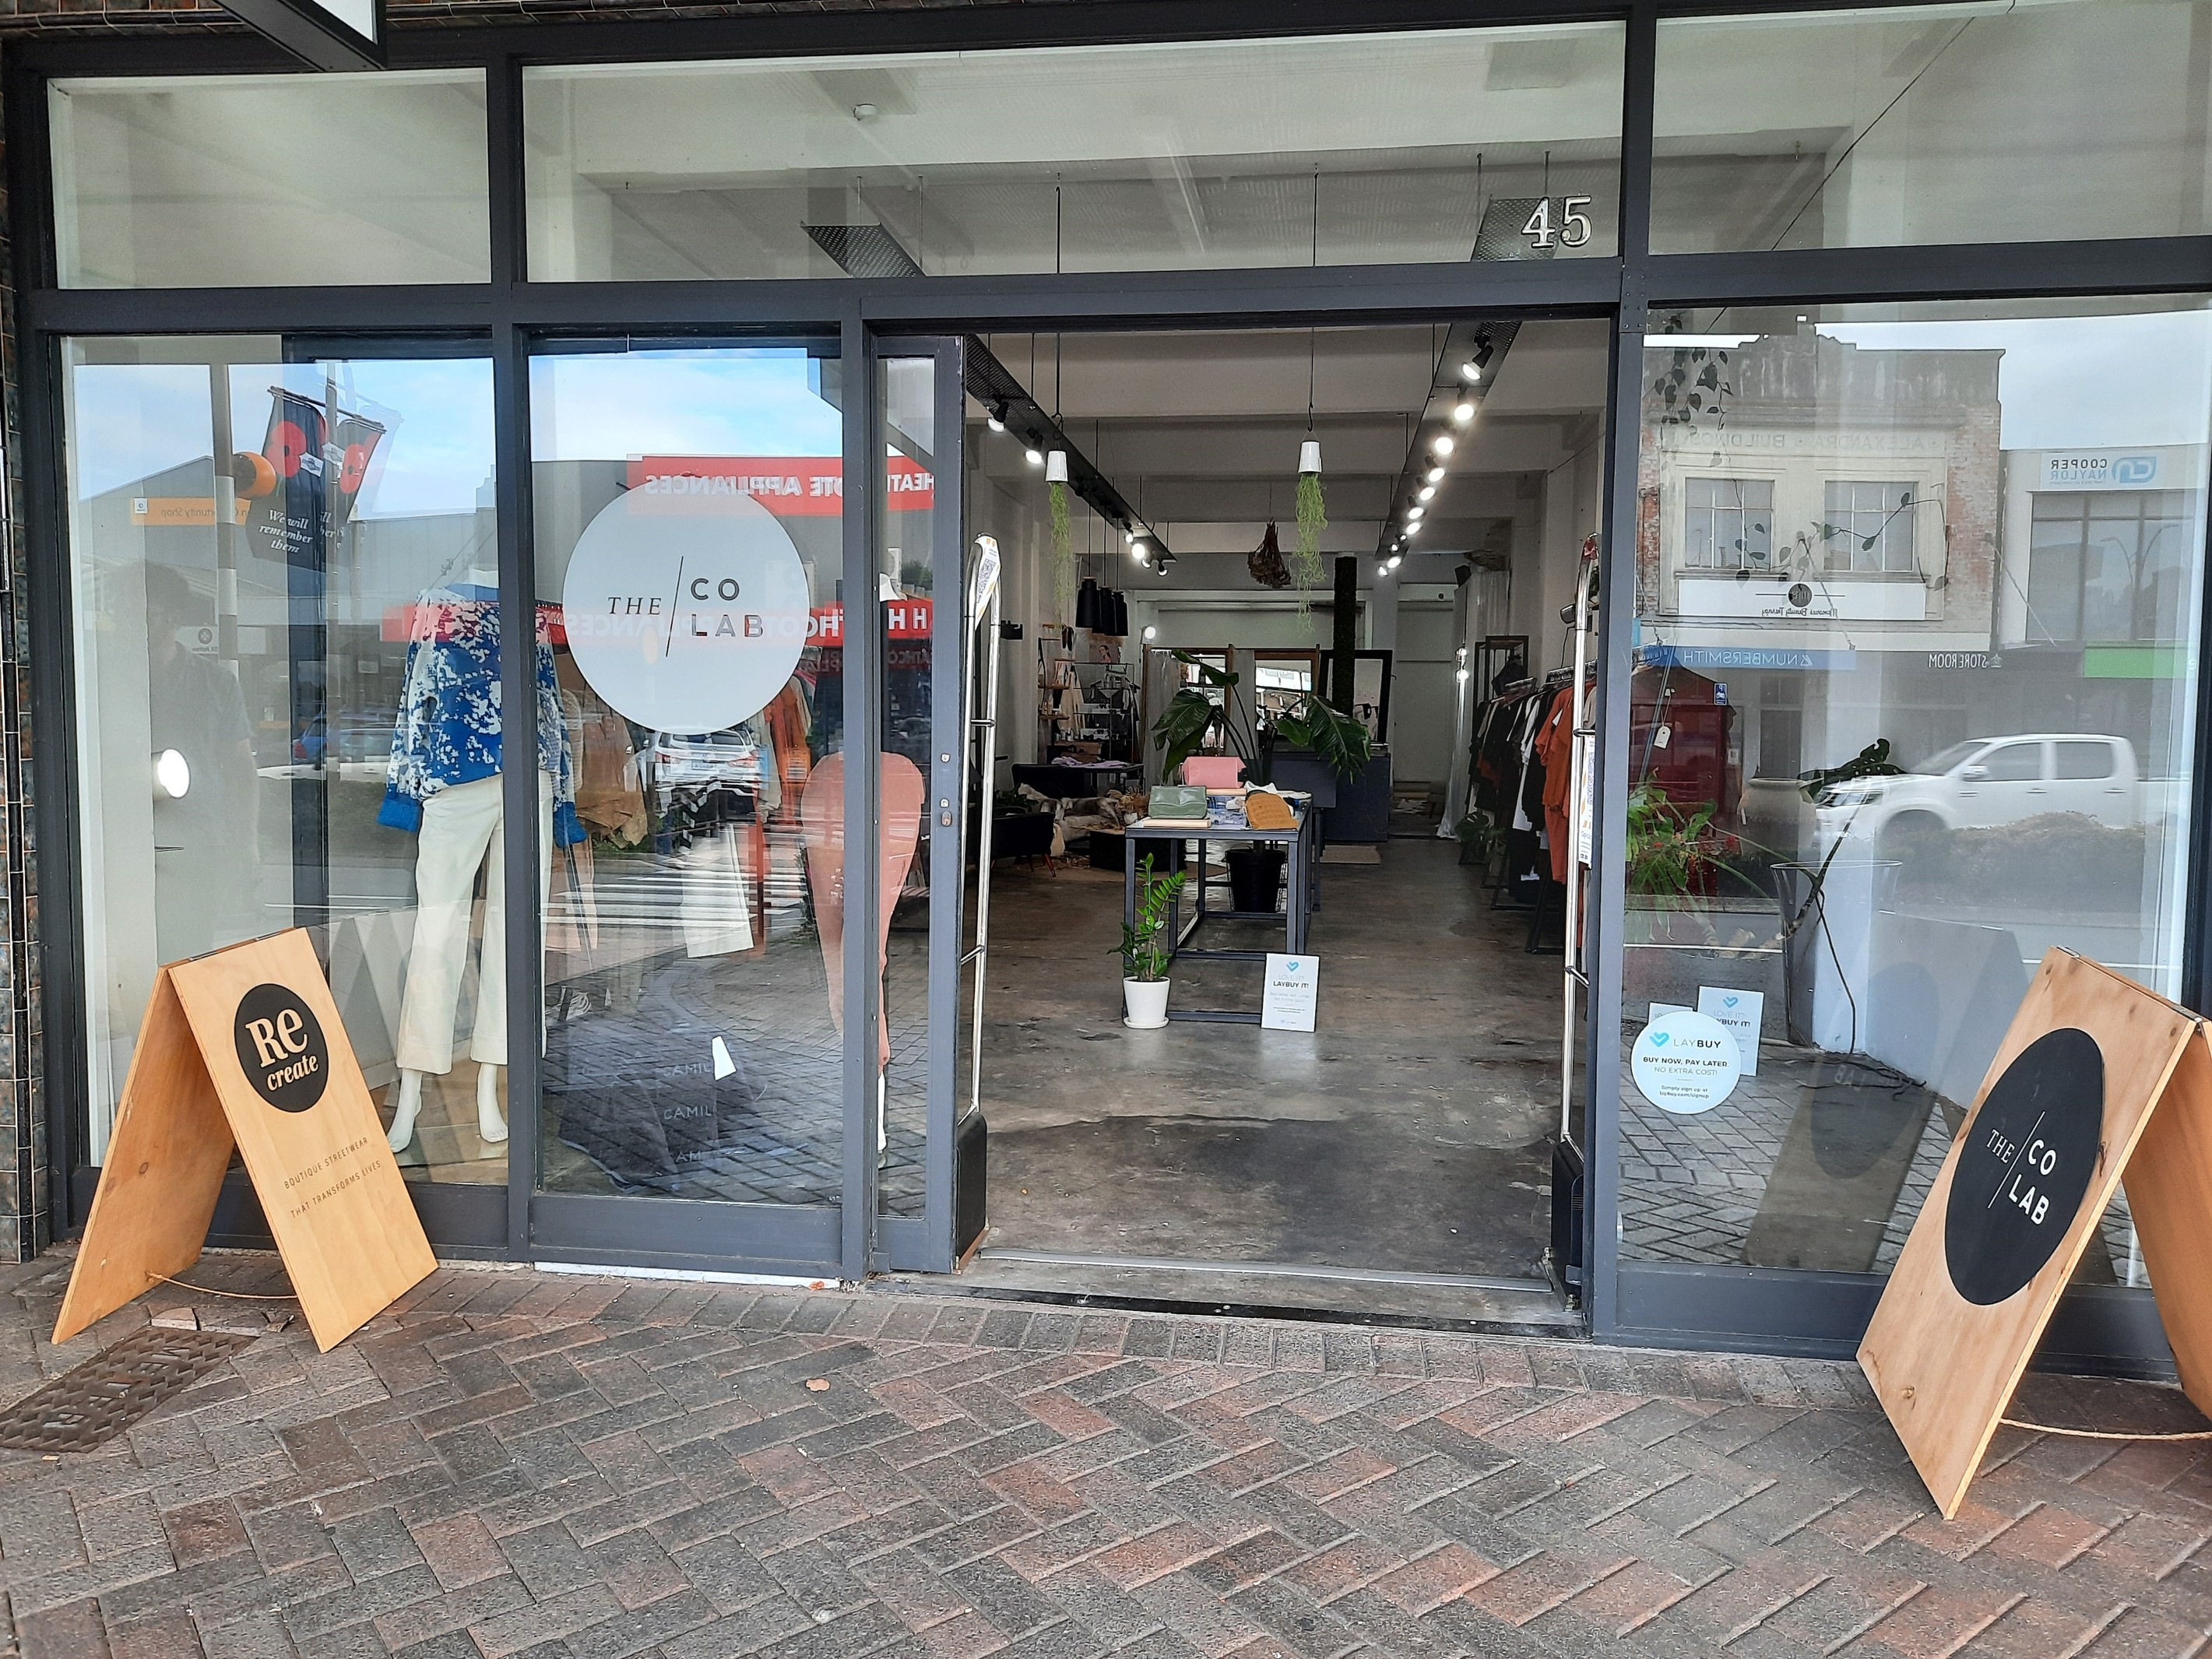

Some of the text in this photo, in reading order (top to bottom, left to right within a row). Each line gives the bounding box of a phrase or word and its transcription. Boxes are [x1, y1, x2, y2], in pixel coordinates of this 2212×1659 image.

[1521, 195, 1591, 248] 45
[258, 524, 313, 544] remember
[269, 508, 309, 530] We will
[271, 539, 300, 554] them
[691, 578, 740, 601] CO
[607, 596, 662, 615] THE
[691, 613, 763, 638] LAB
[1715, 1018, 1739, 1026] YBUY
[245, 1009, 308, 1068] Re
[1673, 1038, 1721, 1049] LAYBUY
[267, 1055, 318, 1091] create
[1986, 1129, 2016, 1164] THE
[2028, 1139, 2057, 1176] CO
[283, 1137, 368, 1190] BOUTIQUE STREETWEAR
[290, 1160, 381, 1218] THAT TRANSFORMS LIVES
[2008, 1172, 2050, 1225] LAB
